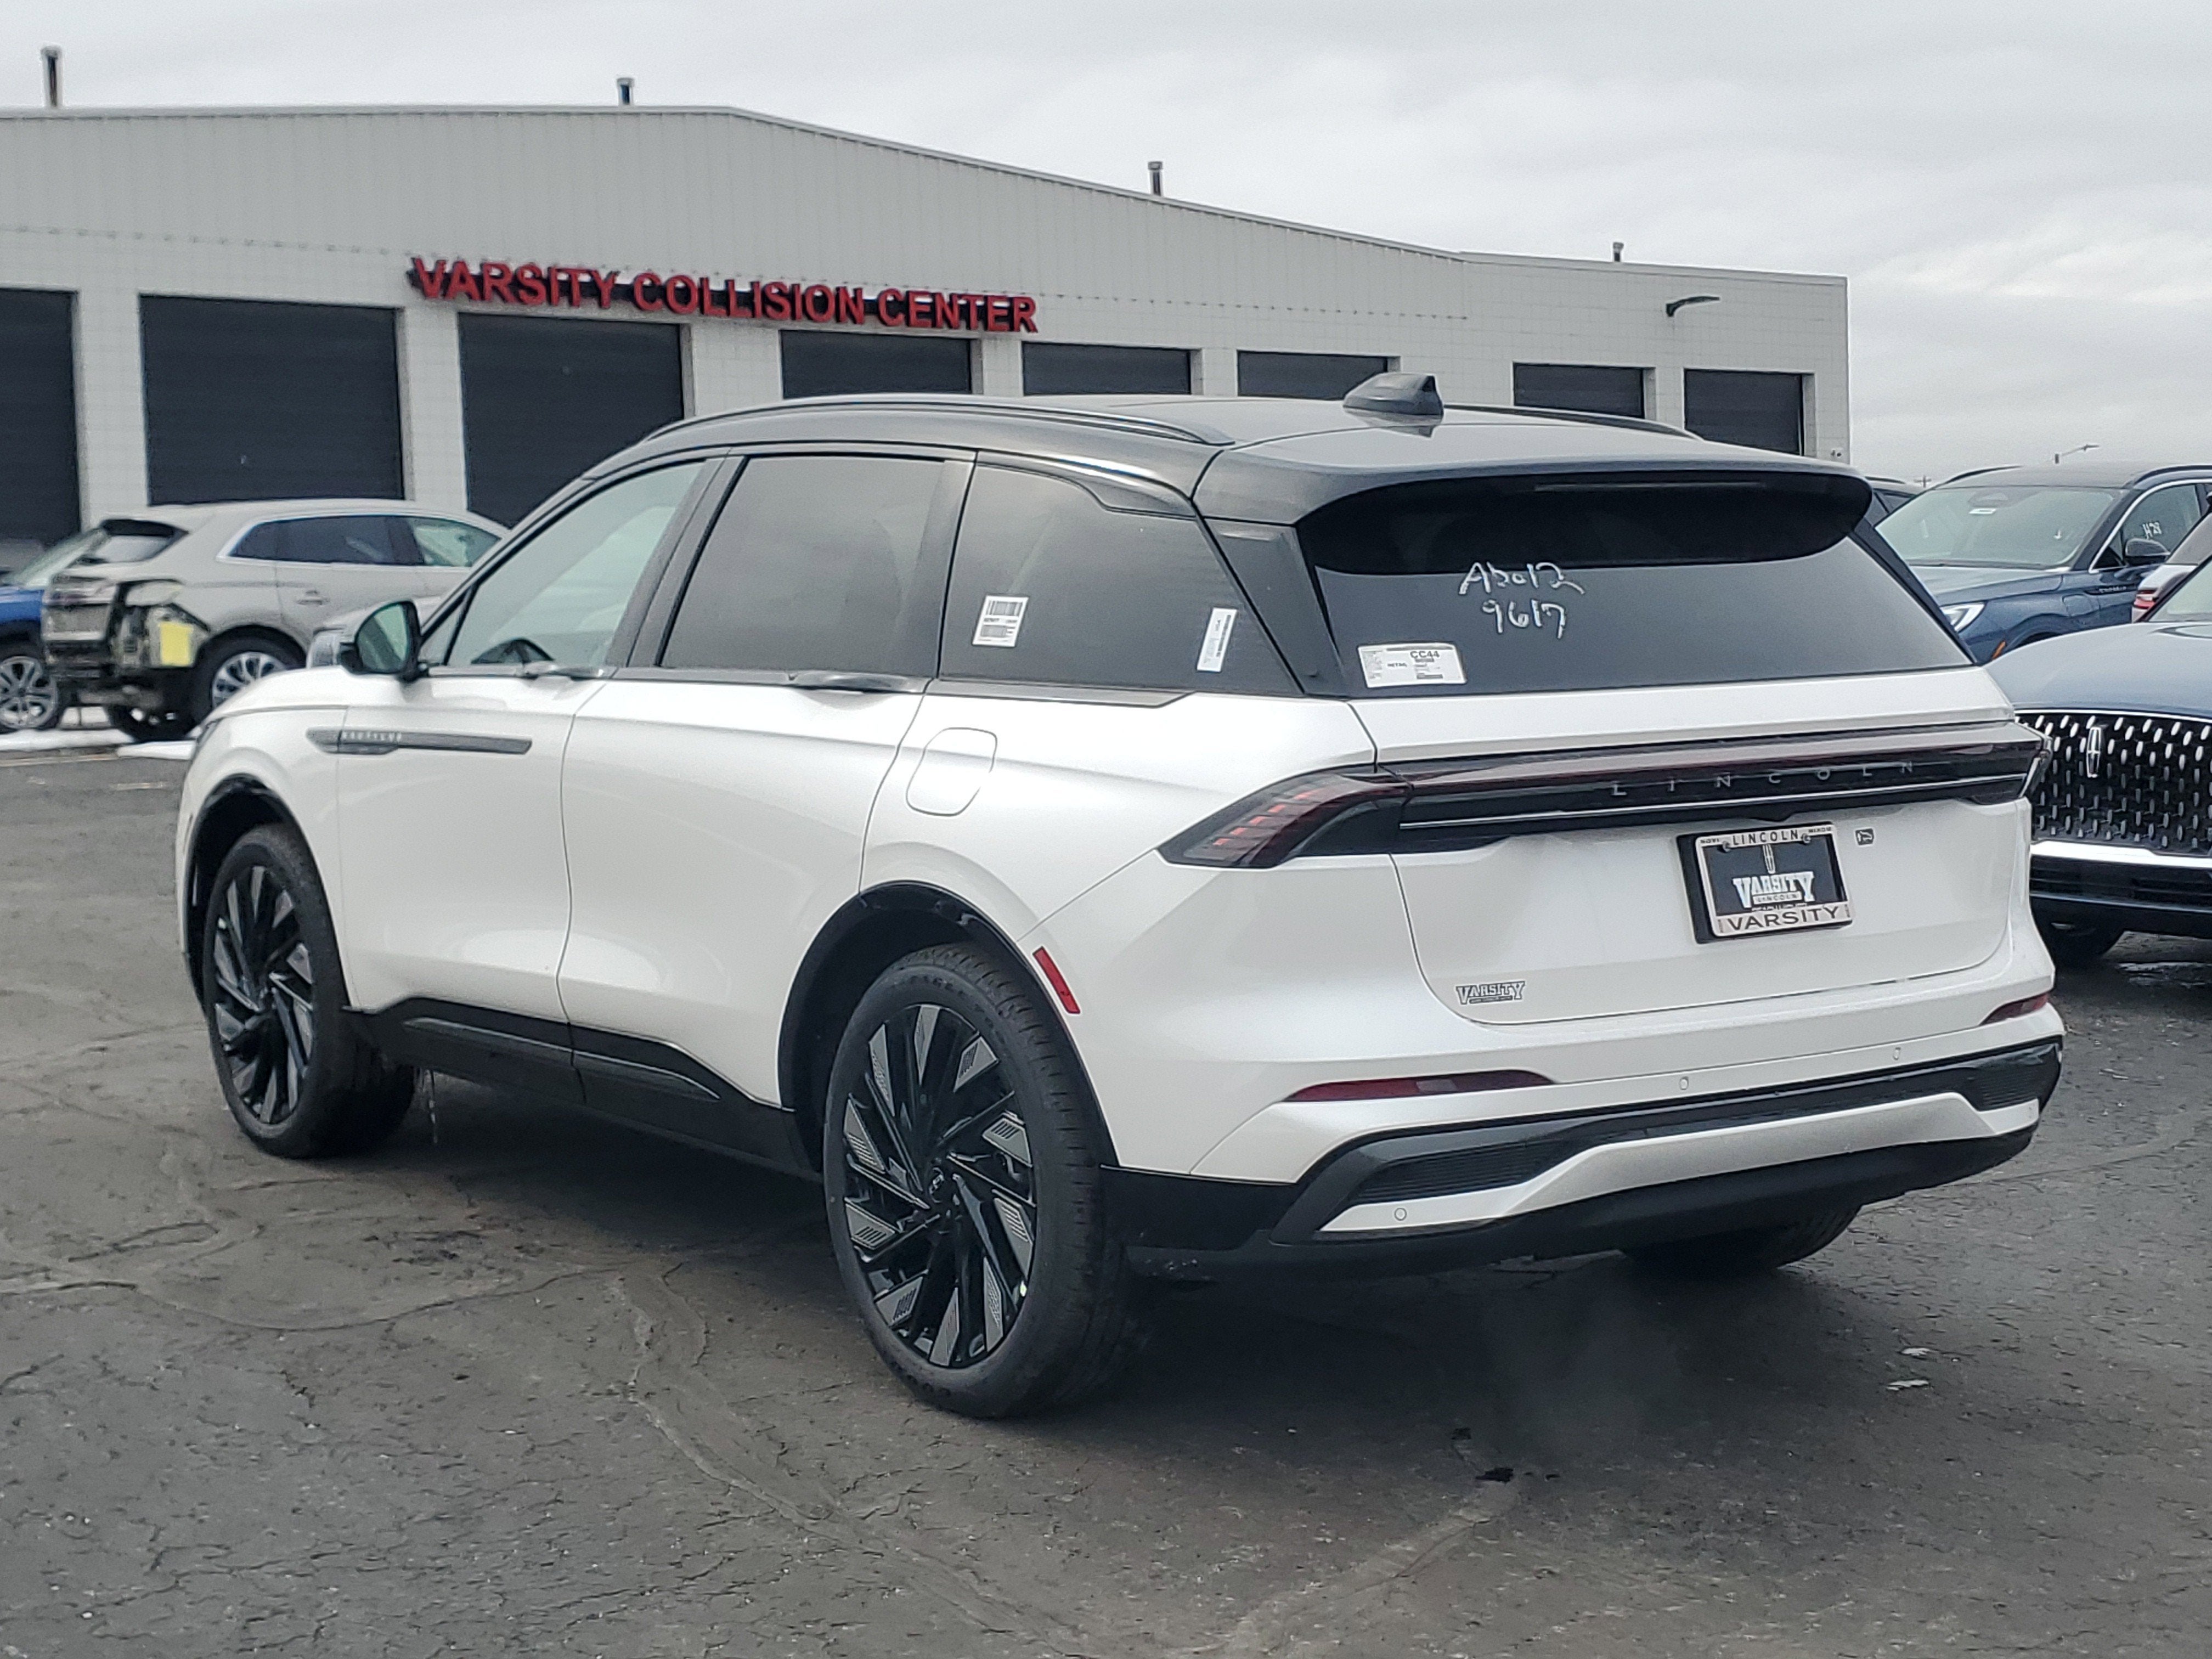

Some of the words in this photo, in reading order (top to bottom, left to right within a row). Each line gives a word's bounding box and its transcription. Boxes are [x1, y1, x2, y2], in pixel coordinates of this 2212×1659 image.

[412, 257, 620, 309] VARSITY
[633, 272, 865, 325] COLLISION
[878, 288, 1038, 333] CENTER
[1482, 599, 1565, 639] 9617
[1611, 761, 1912, 796] LINCOLN
[1733, 829, 1798, 846] LINCOLN
[1733, 871, 1815, 908] VARSITY
[1757, 894, 1798, 903] LINCOLN
[1728, 906, 1839, 931] VARSITY
[1455, 980, 1526, 1005] VARSITY
